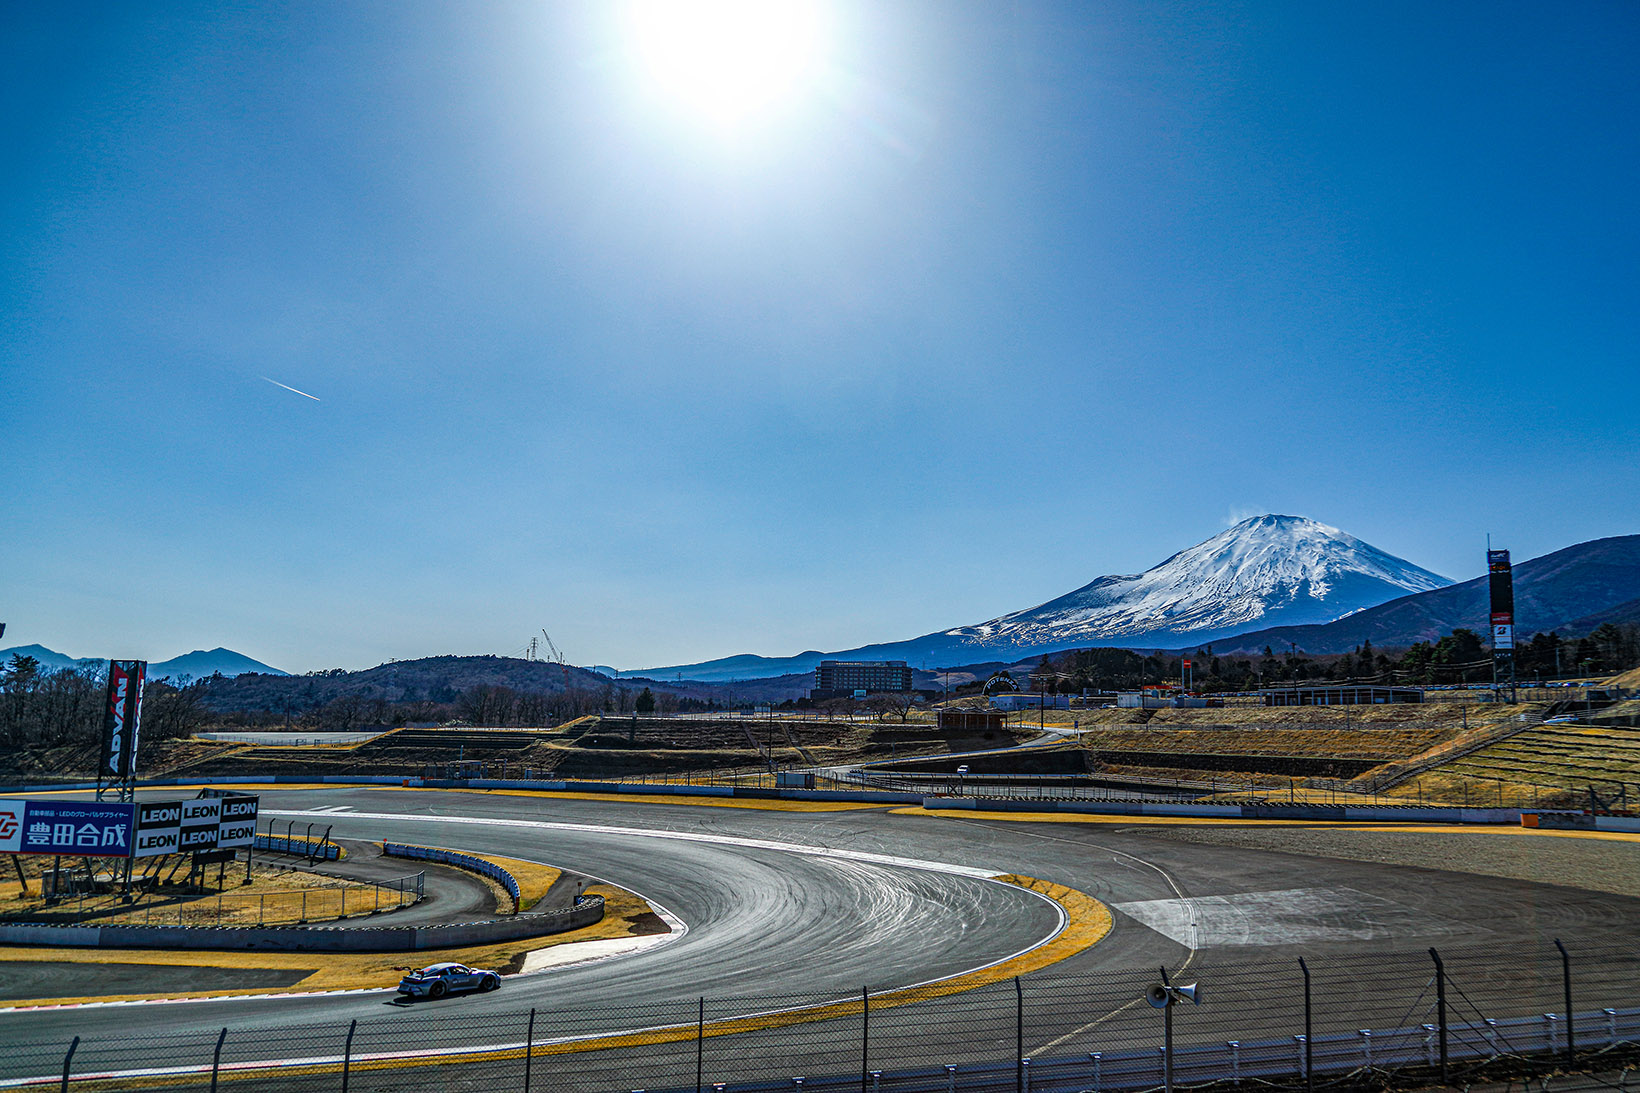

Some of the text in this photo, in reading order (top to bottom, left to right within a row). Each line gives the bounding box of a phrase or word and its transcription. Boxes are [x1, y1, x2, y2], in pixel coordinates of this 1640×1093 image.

[109, 677, 128, 773] ADVAN
[141, 802, 257, 823] LEON LEON LEON
[26, 821, 128, 848] 豊田合成
[138, 826, 254, 850] LEON LEON LEON
